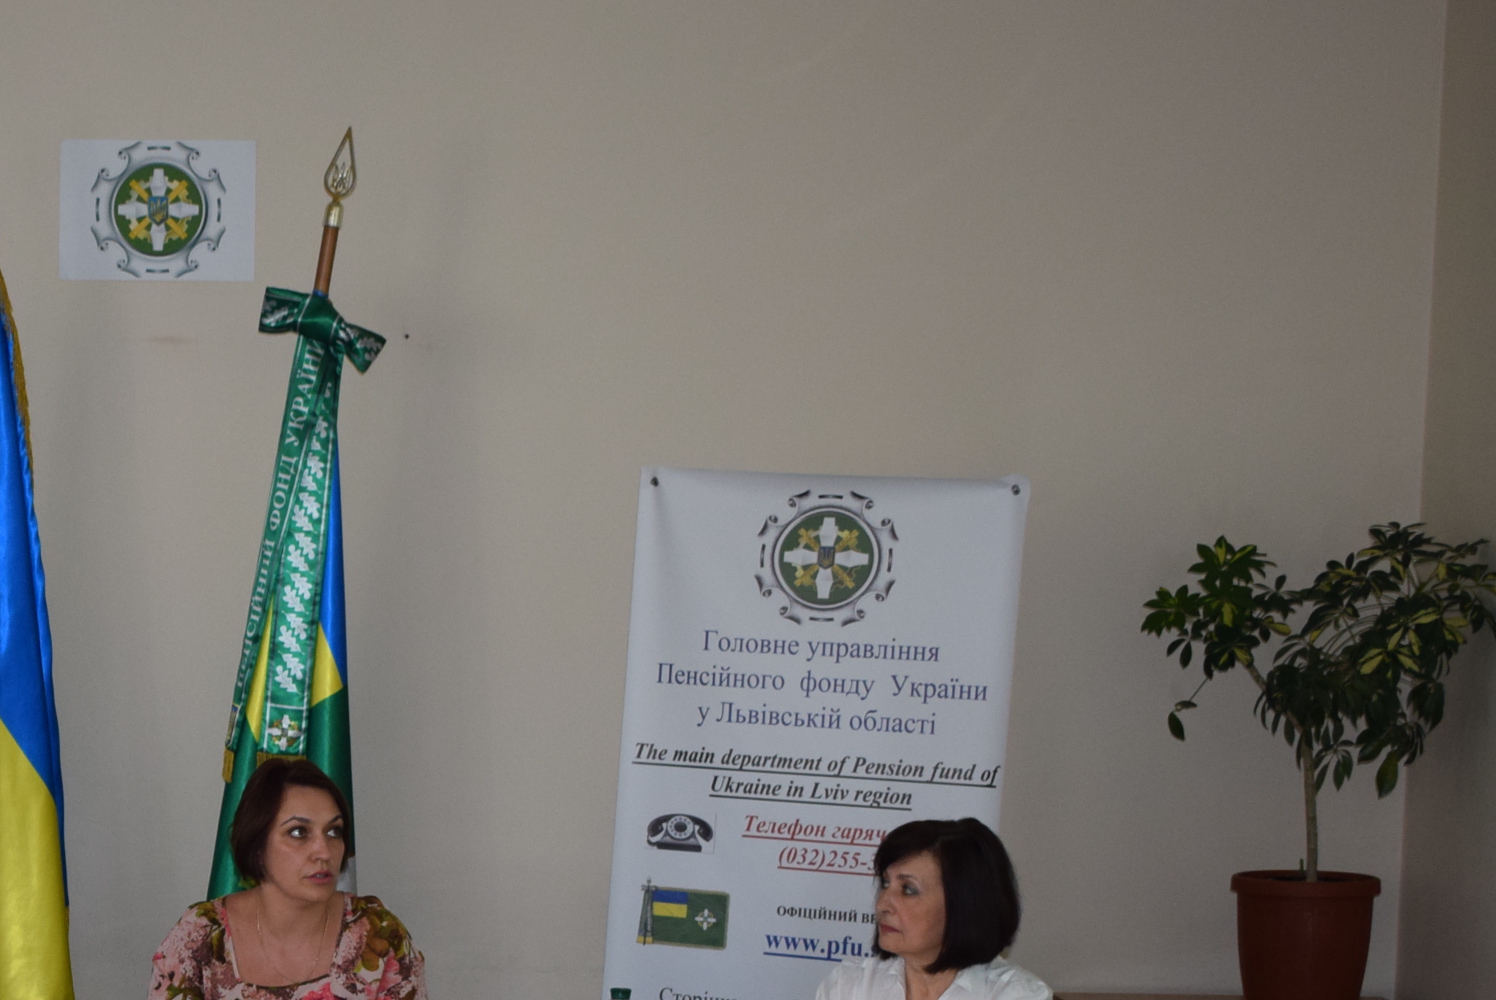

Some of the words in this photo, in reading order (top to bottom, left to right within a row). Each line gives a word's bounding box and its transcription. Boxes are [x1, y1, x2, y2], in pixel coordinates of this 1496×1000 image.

[270, 456, 299, 531] ФОНД
[703, 630, 799, 655] Головне
[806, 638, 940, 663] управління
[656, 663, 785, 690] Пенсійного
[799, 670, 875, 700] фонду
[890, 673, 988, 704] України
[697, 706, 710, 727] у
[716, 702, 841, 730] Львівській
[849, 710, 937, 735] області
[635, 742, 668, 761] The
[672, 747, 715, 764] main
[721, 748, 822, 771] department
[827, 755, 850, 777] of
[852, 756, 925, 778] Pension
[927, 762, 977, 783] fund
[980, 765, 1001, 787] of
[710, 775, 782, 797] Ukraine
[786, 780, 804, 798] in
[810, 781, 849, 801] Lviv
[854, 787, 912, 808] region
[744, 815, 826, 840] Телефон
[766, 936, 874, 960] www.pfu.
